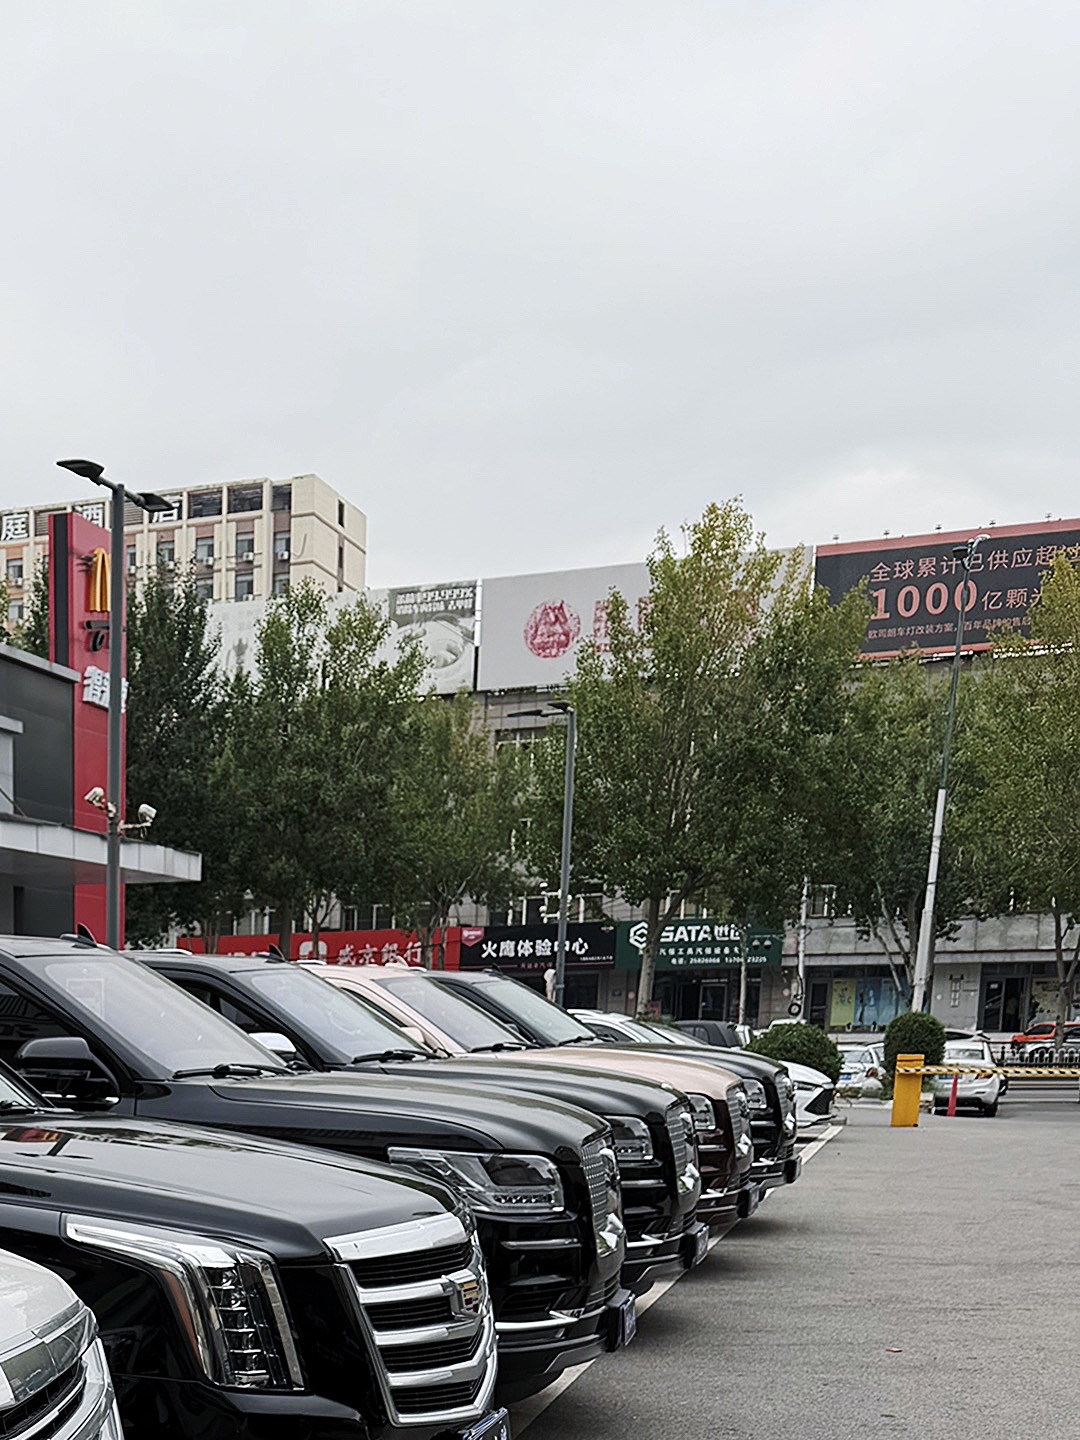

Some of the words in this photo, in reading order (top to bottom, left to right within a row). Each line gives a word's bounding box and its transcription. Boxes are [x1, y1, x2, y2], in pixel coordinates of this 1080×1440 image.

[481, 937, 589, 959] 火鹰体验中心
